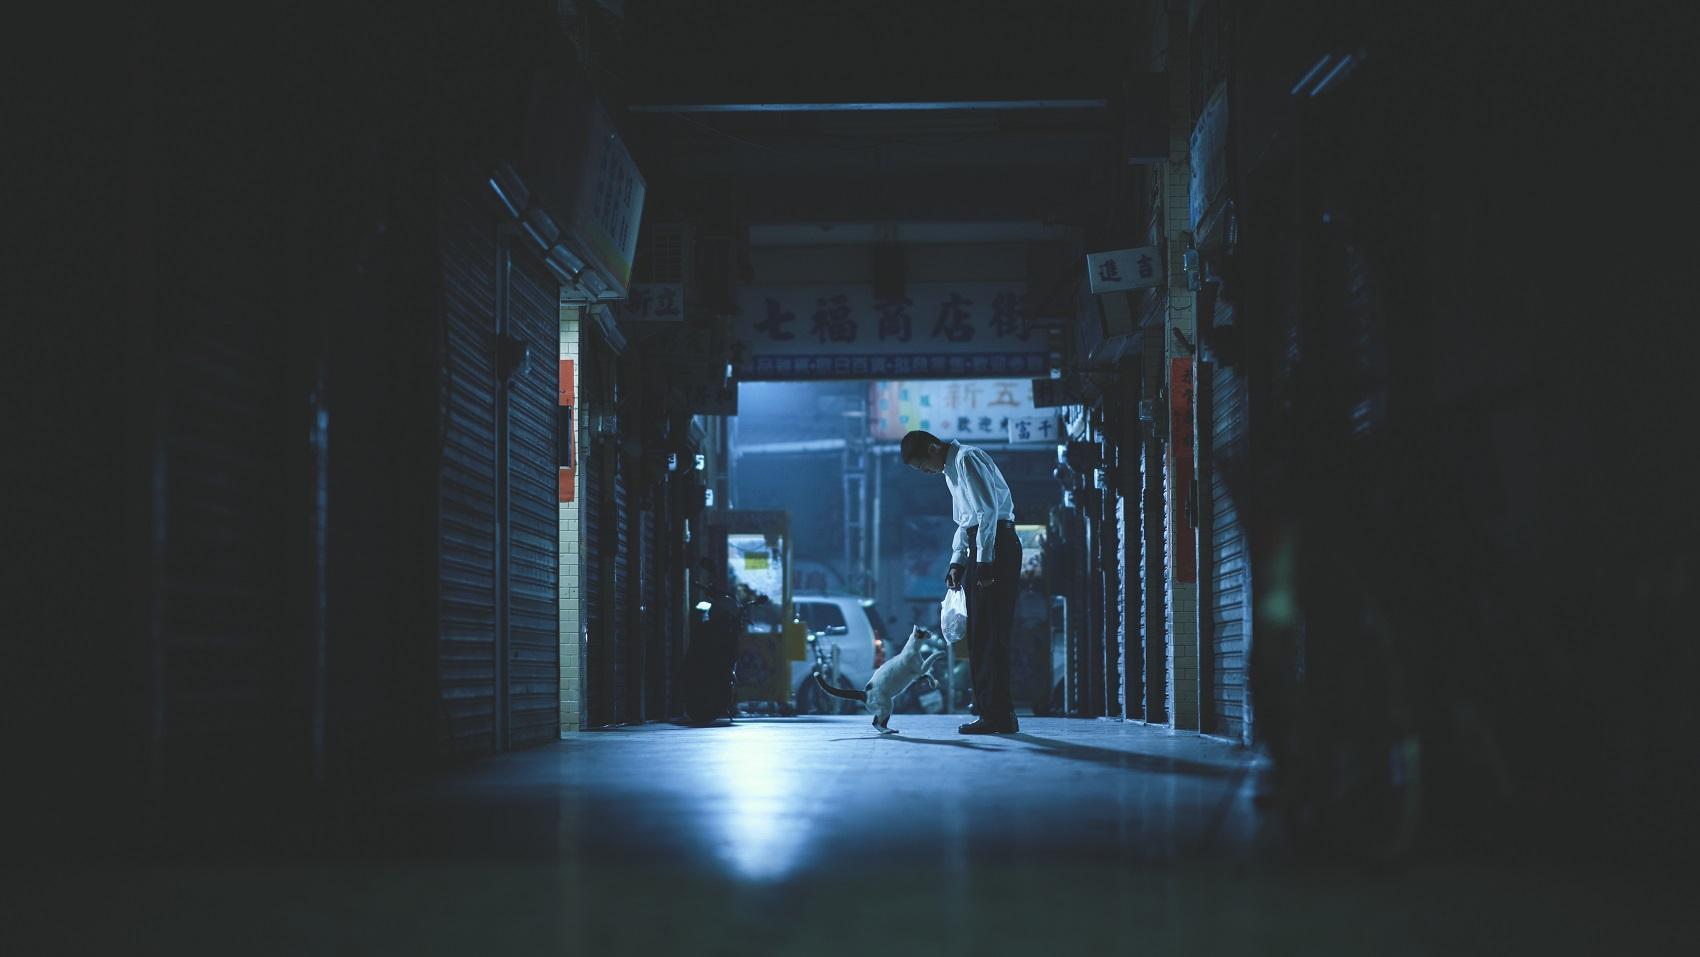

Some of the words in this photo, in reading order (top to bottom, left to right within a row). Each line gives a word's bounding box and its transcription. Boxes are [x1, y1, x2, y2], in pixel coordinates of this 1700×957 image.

[752, 293, 1031, 343] 七福商店街
[946, 382, 1032, 408] 新五
